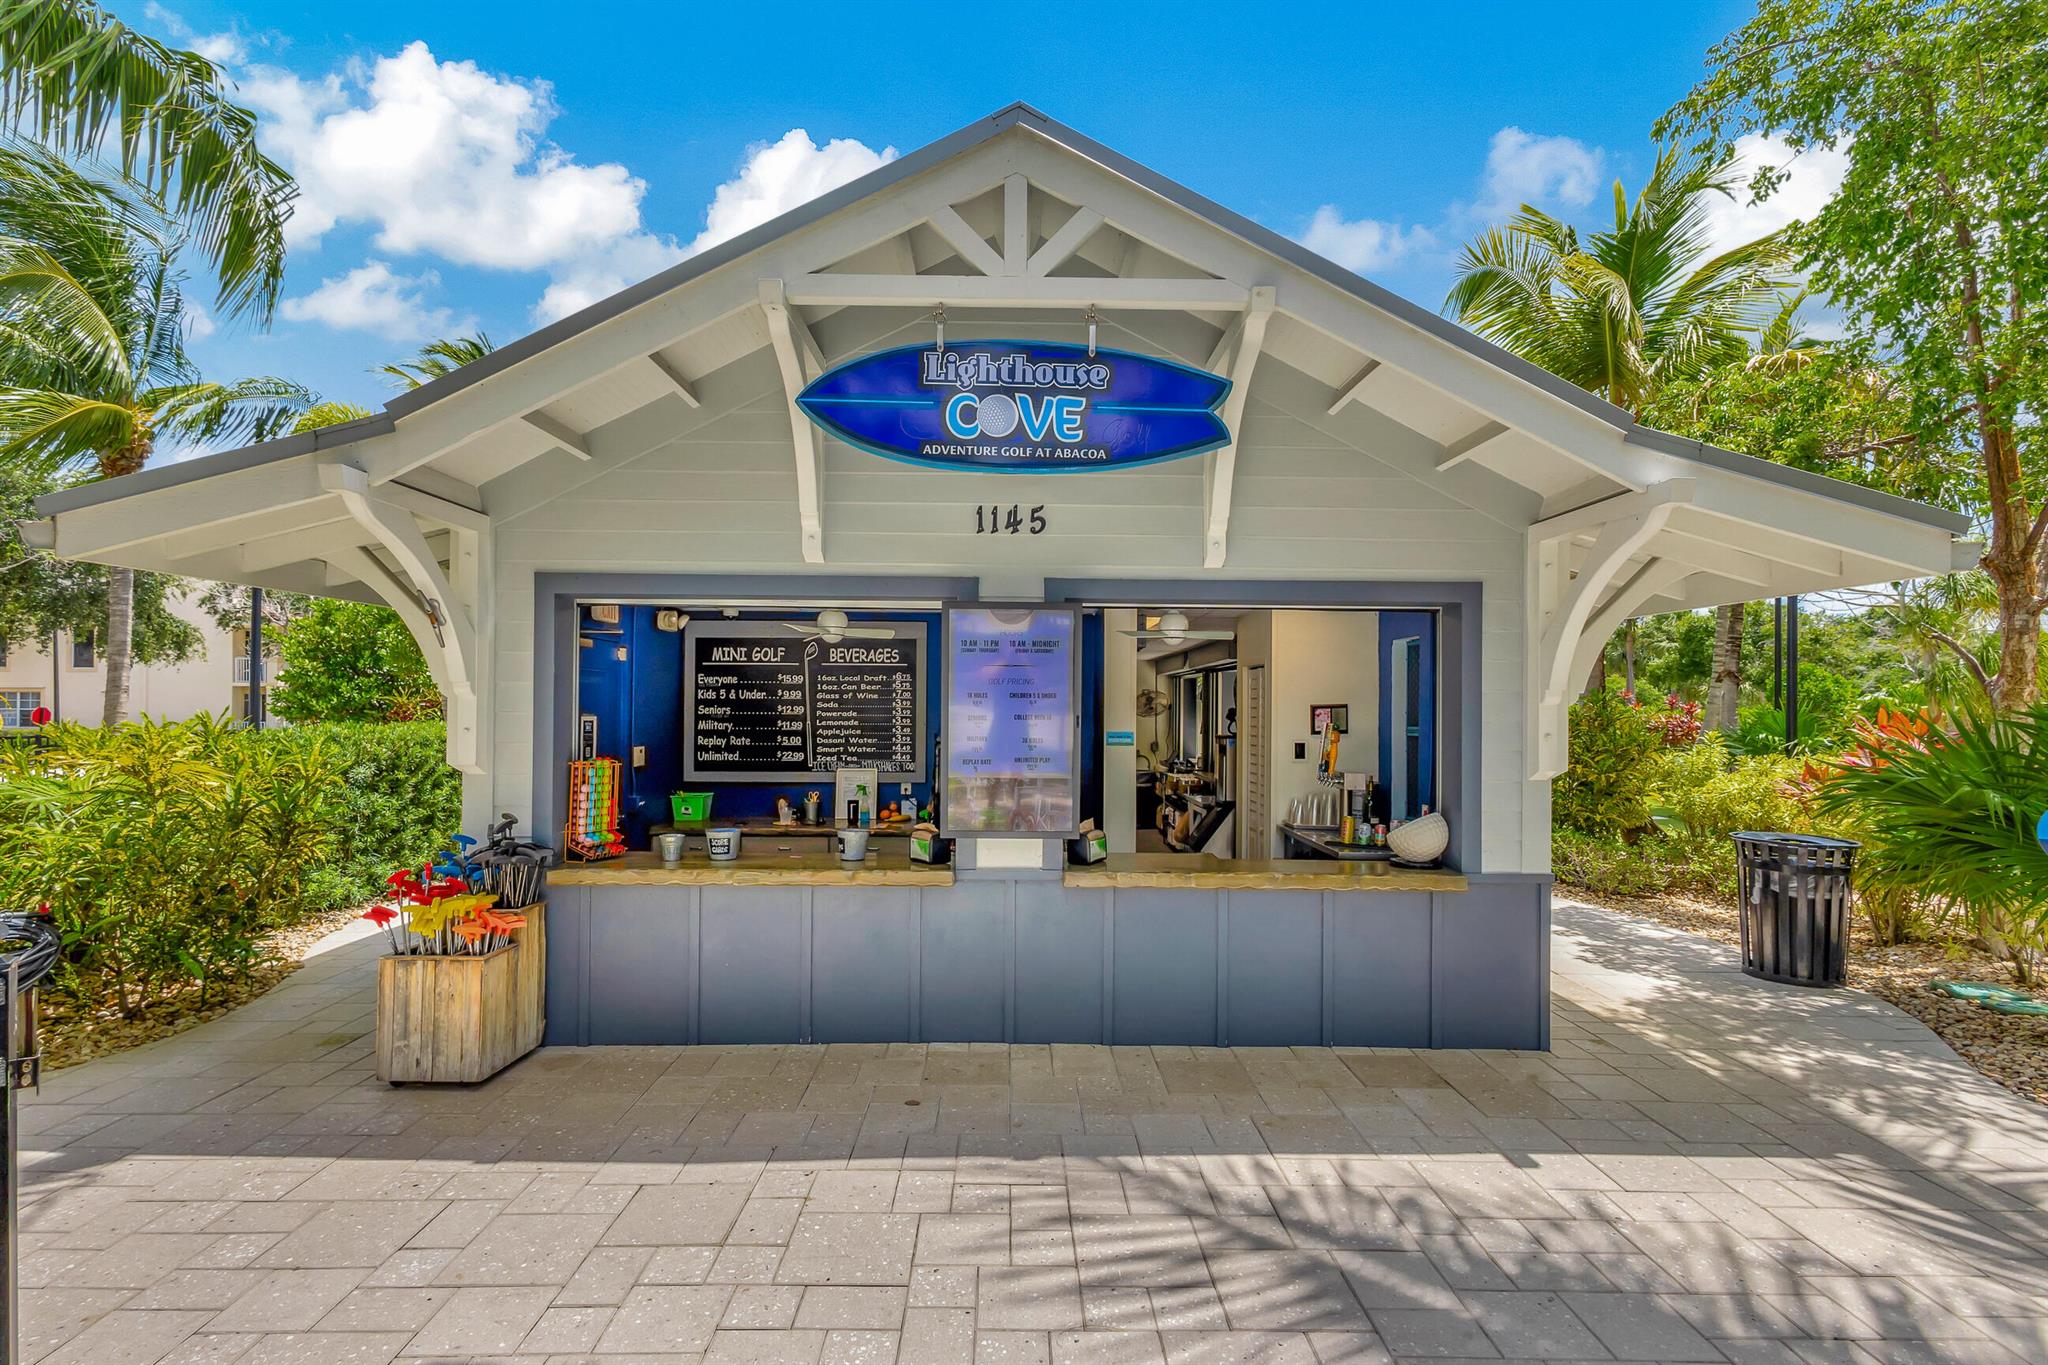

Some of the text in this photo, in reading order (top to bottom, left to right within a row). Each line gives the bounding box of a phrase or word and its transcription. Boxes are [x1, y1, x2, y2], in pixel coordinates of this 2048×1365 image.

[923, 351, 1110, 390] Lighthouse
[922, 444, 1107, 460] ADVENTURE GOLF AT ABACOA
[975, 504, 1048, 535] 1145
[1032, 640, 1060, 648] MIDNIGHT
[712, 647, 786, 662] MINI GOLF
[830, 648, 899, 662] BEVERAGES
[698, 674, 738, 686] Everyone
[698, 689, 716, 699] Kids
[719, 689, 726, 699] 5
[729, 689, 736, 699] &
[739, 689, 766, 699] Under
[698, 705, 731, 714] Seniors
[698, 720, 732, 732] Military
[697, 736, 727, 748] Replay
[730, 736, 751, 745] Rate
[697, 751, 739, 761] Unlimited
